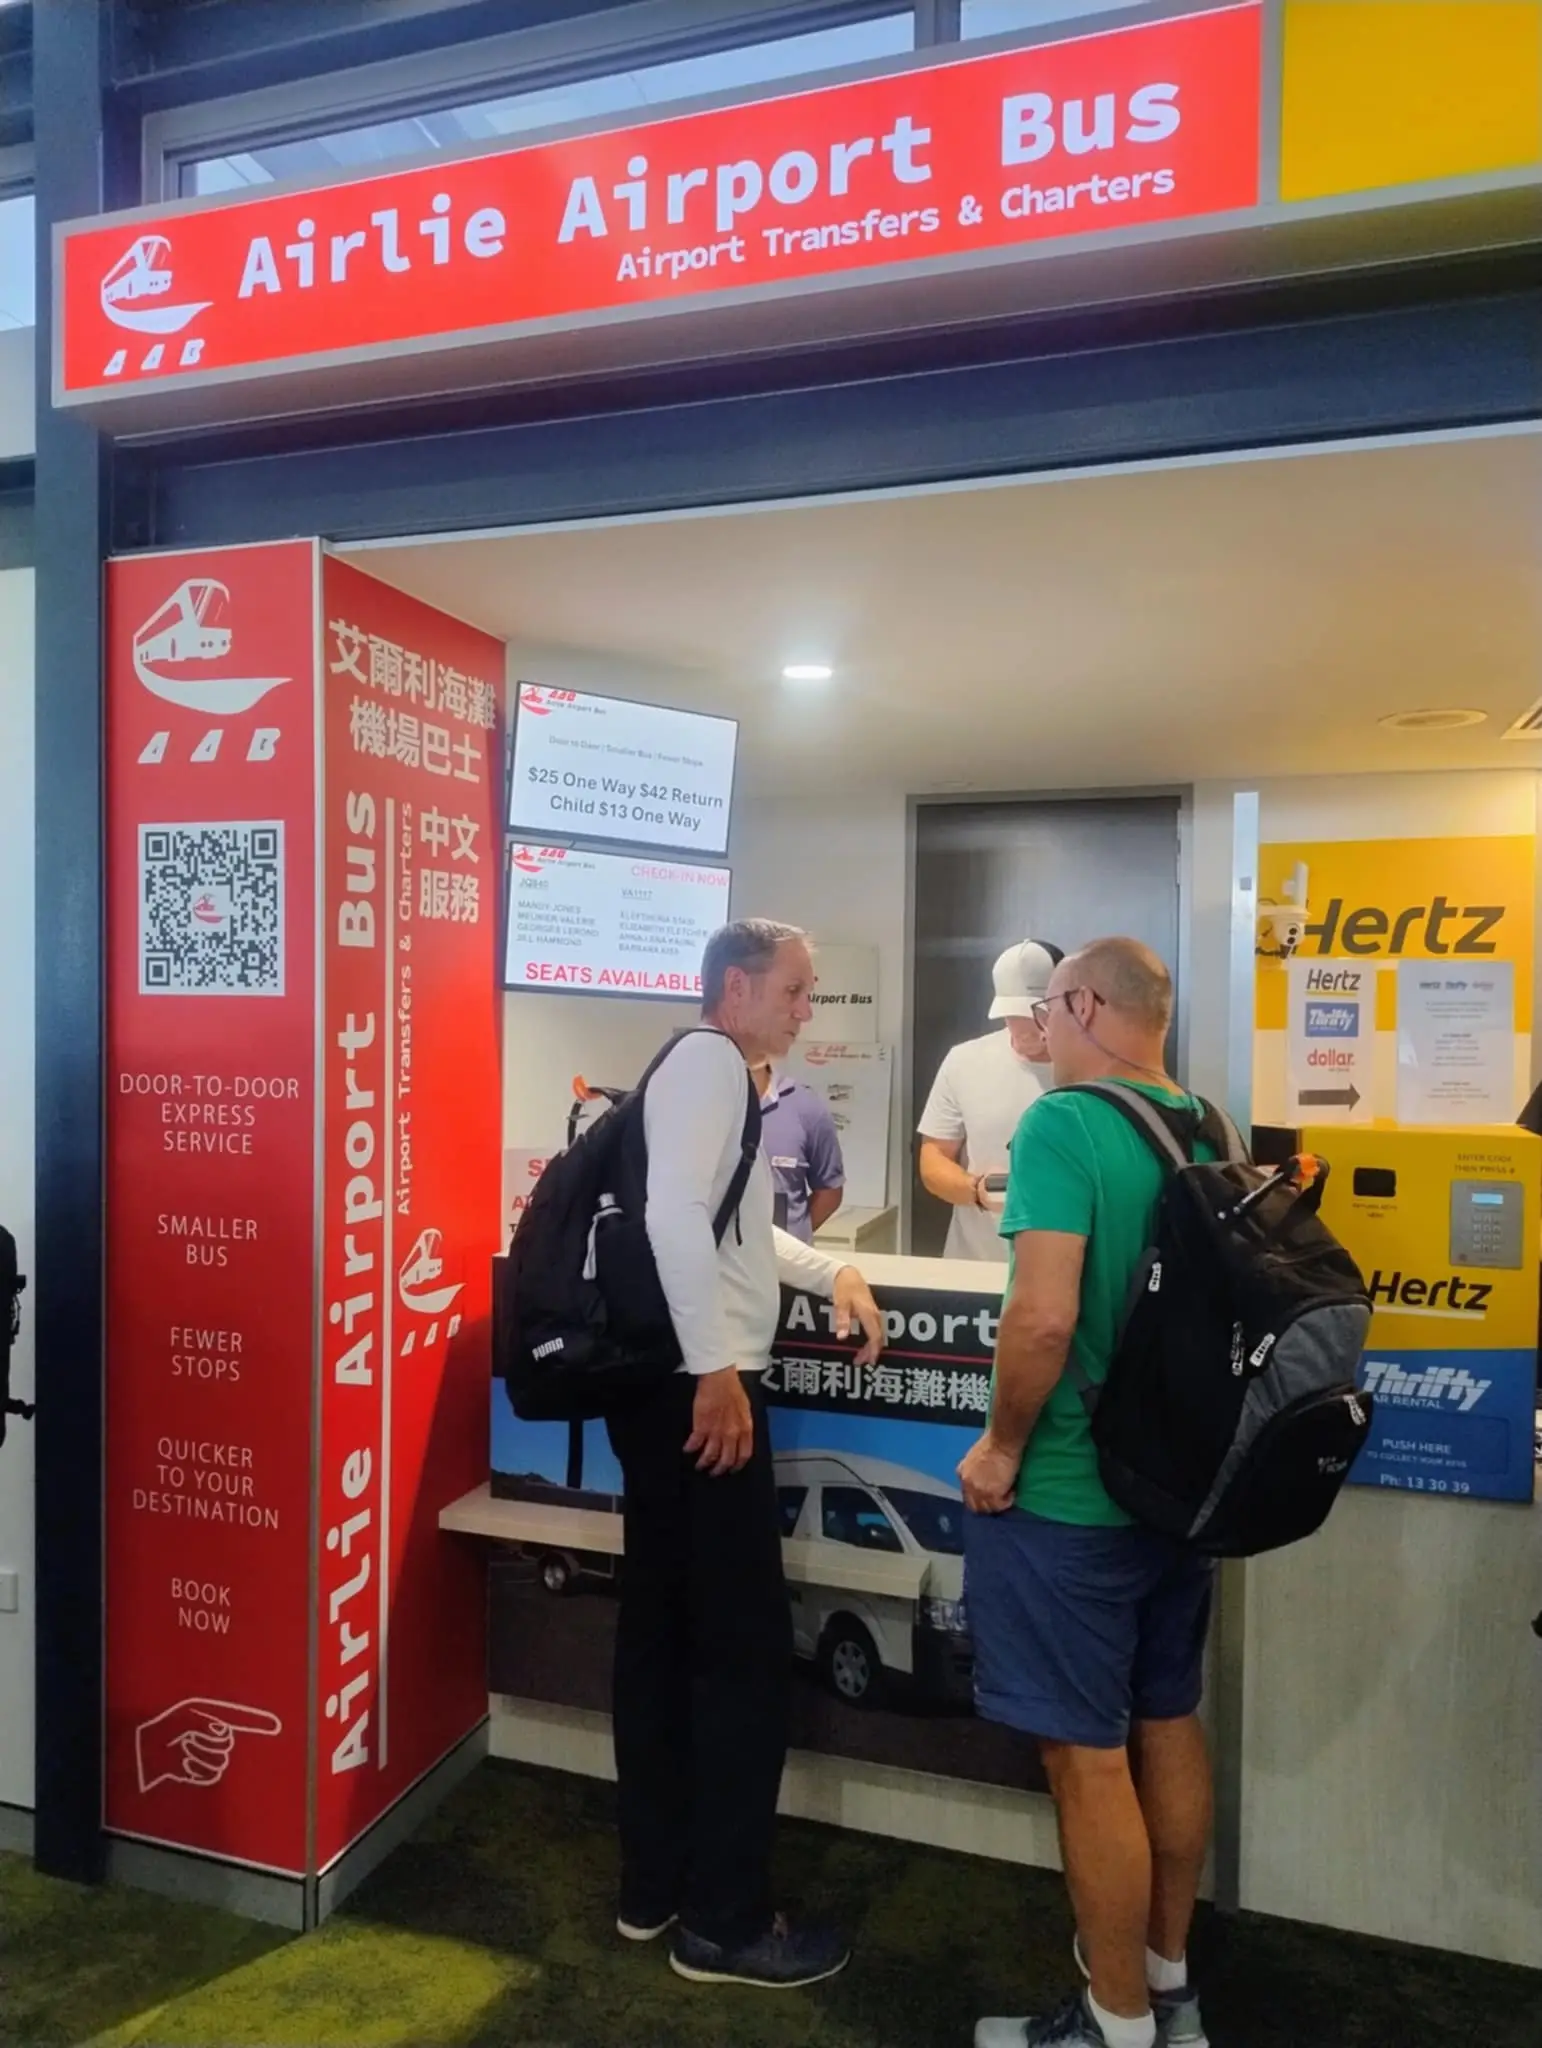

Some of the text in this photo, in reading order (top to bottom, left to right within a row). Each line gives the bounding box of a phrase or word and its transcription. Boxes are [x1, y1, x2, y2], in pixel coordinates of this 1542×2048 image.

[239, 83, 1181, 299] Airlie Airport Bus
[617, 168, 1175, 282] Airport Transfers & Charters
[329, 618, 496, 731] 艾爾利海灘
[349, 695, 482, 784] 機場巴士
[528, 766, 723, 809] $25 One Way $42 Return
[550, 795, 701, 832] Child $13 One Way
[419, 806, 480, 864] 中文
[631, 865, 728, 887] CHECK-IN NOW
[419, 868, 479, 924] 服務
[526, 962, 593, 984] SEATS
[1306, 968, 1361, 991] Hertz
[397, 802, 414, 1215] Airport Transfers & Charters
[850, 993, 872, 1004] Bus
[1310, 1008, 1355, 1031] Thrifty
[119, 1073, 299, 1099] DOOR-TO-DOOR
[161, 1103, 256, 1127] EXPRESS
[163, 1131, 253, 1155] SERVICE
[158, 1214, 258, 1240] SMALLER
[186, 1244, 228, 1267] BUS
[325, 790, 383, 1775] Airlie Airport Bus
[1368, 1270, 1492, 1310] Hertz
[170, 1327, 242, 1352] FEWER
[532, 1337, 564, 1361] PUMA
[171, 1355, 240, 1381] STOPS
[1364, 1361, 1492, 1411] Thrifty
[1392, 1396, 1444, 1410] RENTAL
[157, 1437, 253, 1468] QUICKER
[1382, 1438, 1451, 1455] PUSH HERE
[156, 1465, 254, 1497] TO YOUR
[1407, 1476, 1424, 1489] 13
[1428, 1478, 1447, 1492] 30
[1452, 1481, 1470, 1493] 39
[133, 1489, 279, 1530] DESTINATION
[171, 1578, 231, 1607] BOOK
[179, 1606, 230, 1634] NOW
